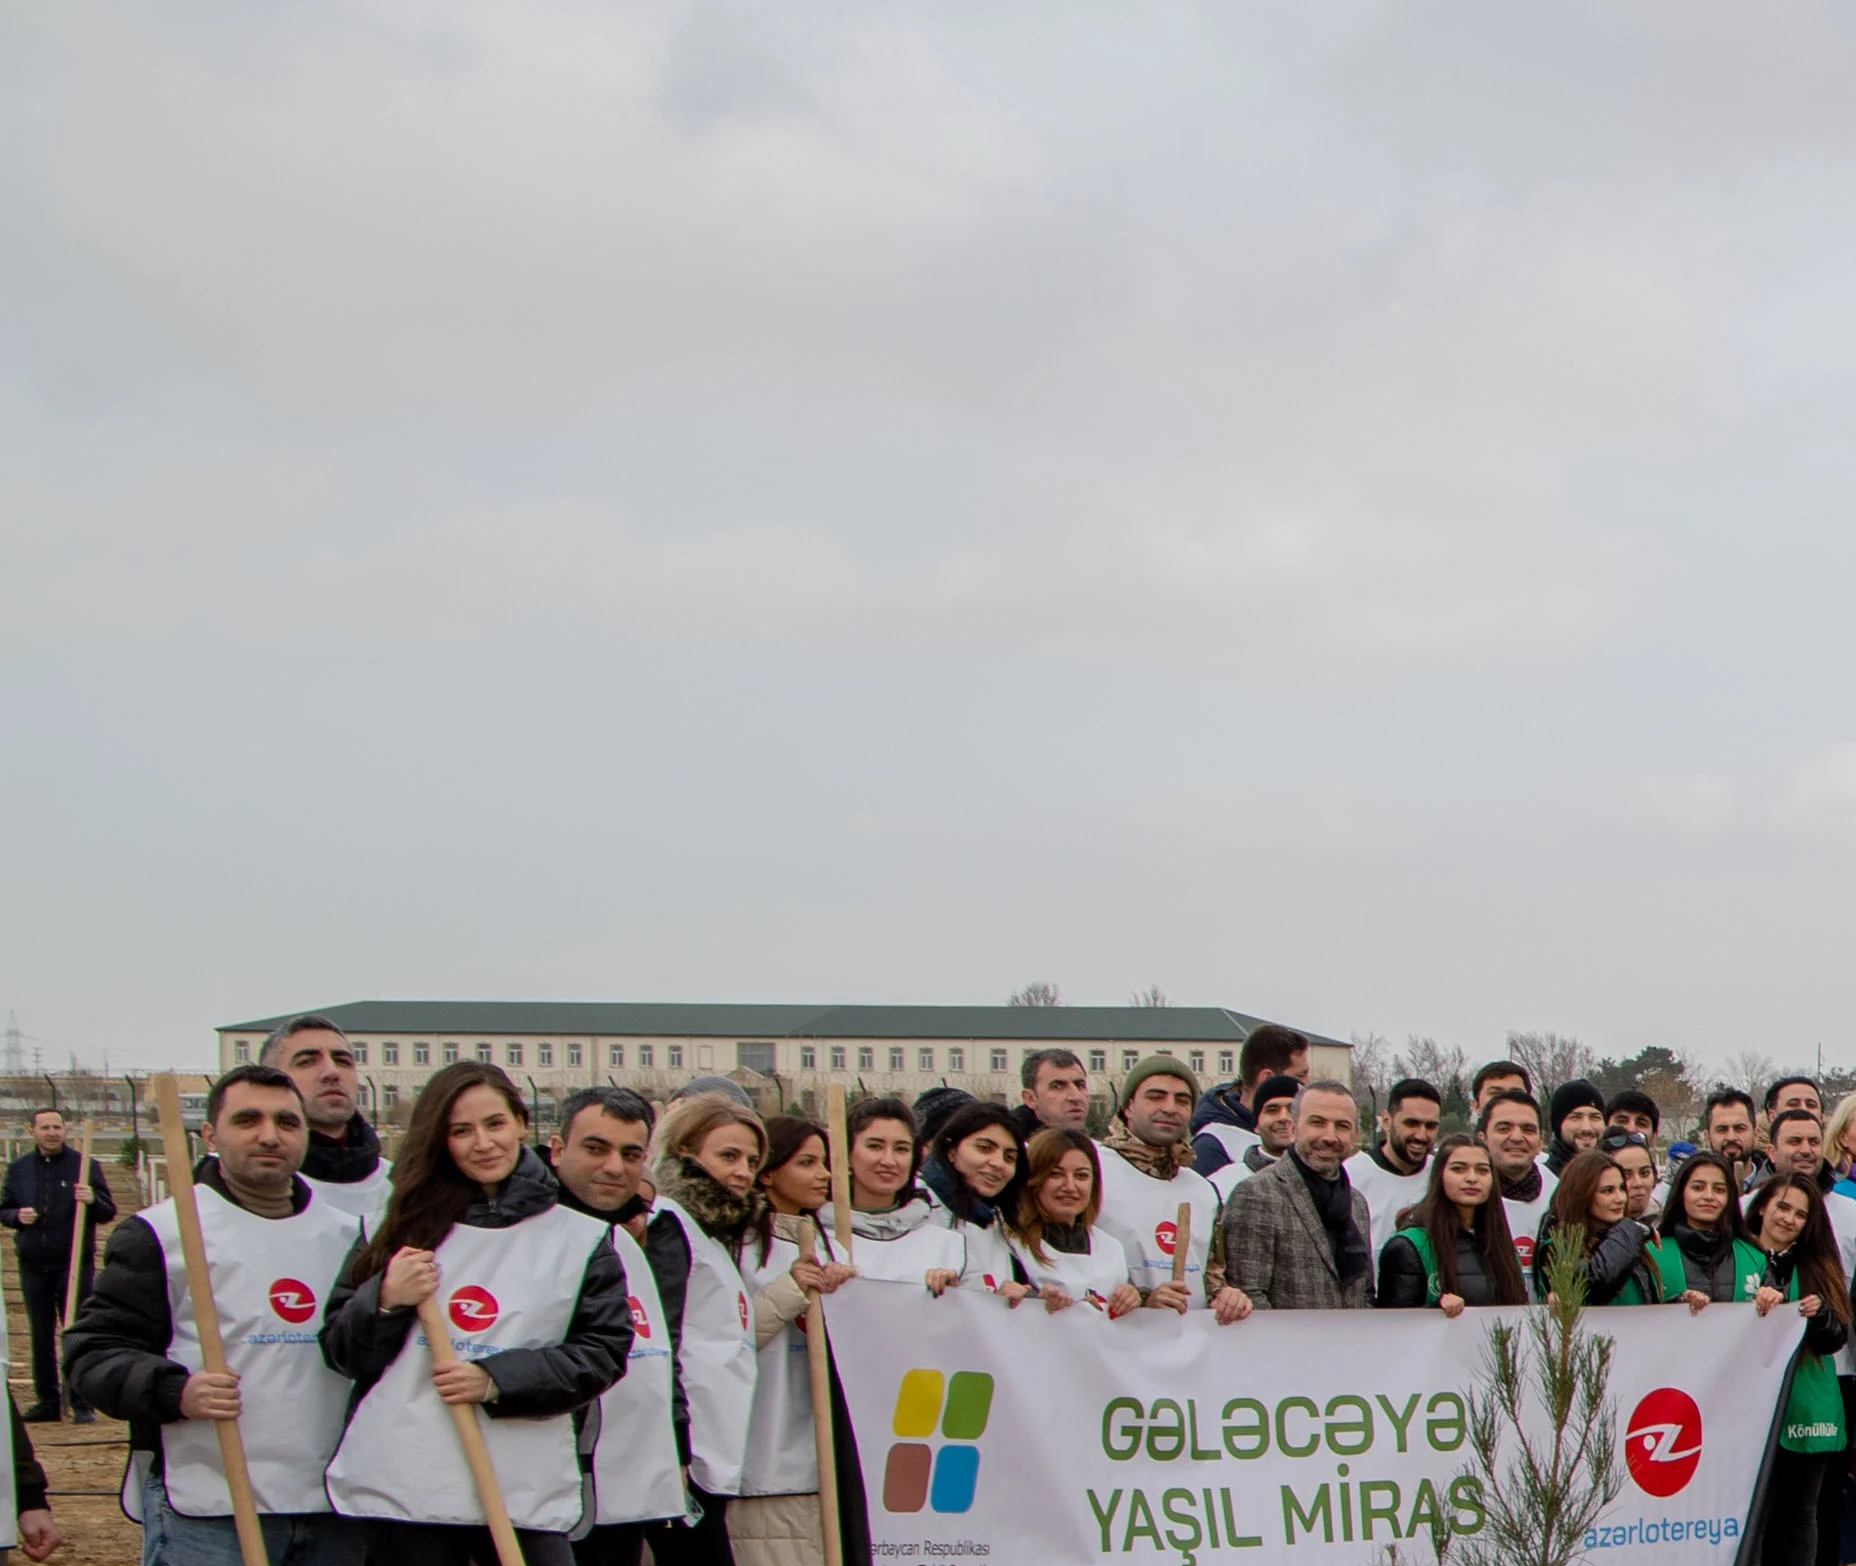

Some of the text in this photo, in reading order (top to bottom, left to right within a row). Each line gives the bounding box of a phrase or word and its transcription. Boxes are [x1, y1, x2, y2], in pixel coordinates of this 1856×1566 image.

[1102, 1392, 1466, 1461] GƏLƏCƏYƏ
[1280, 1463, 1486, 1546] MİRAS
[924, 1540, 990, 1559] Respublikası
[1584, 1516, 1740, 1549] azərlotereya
